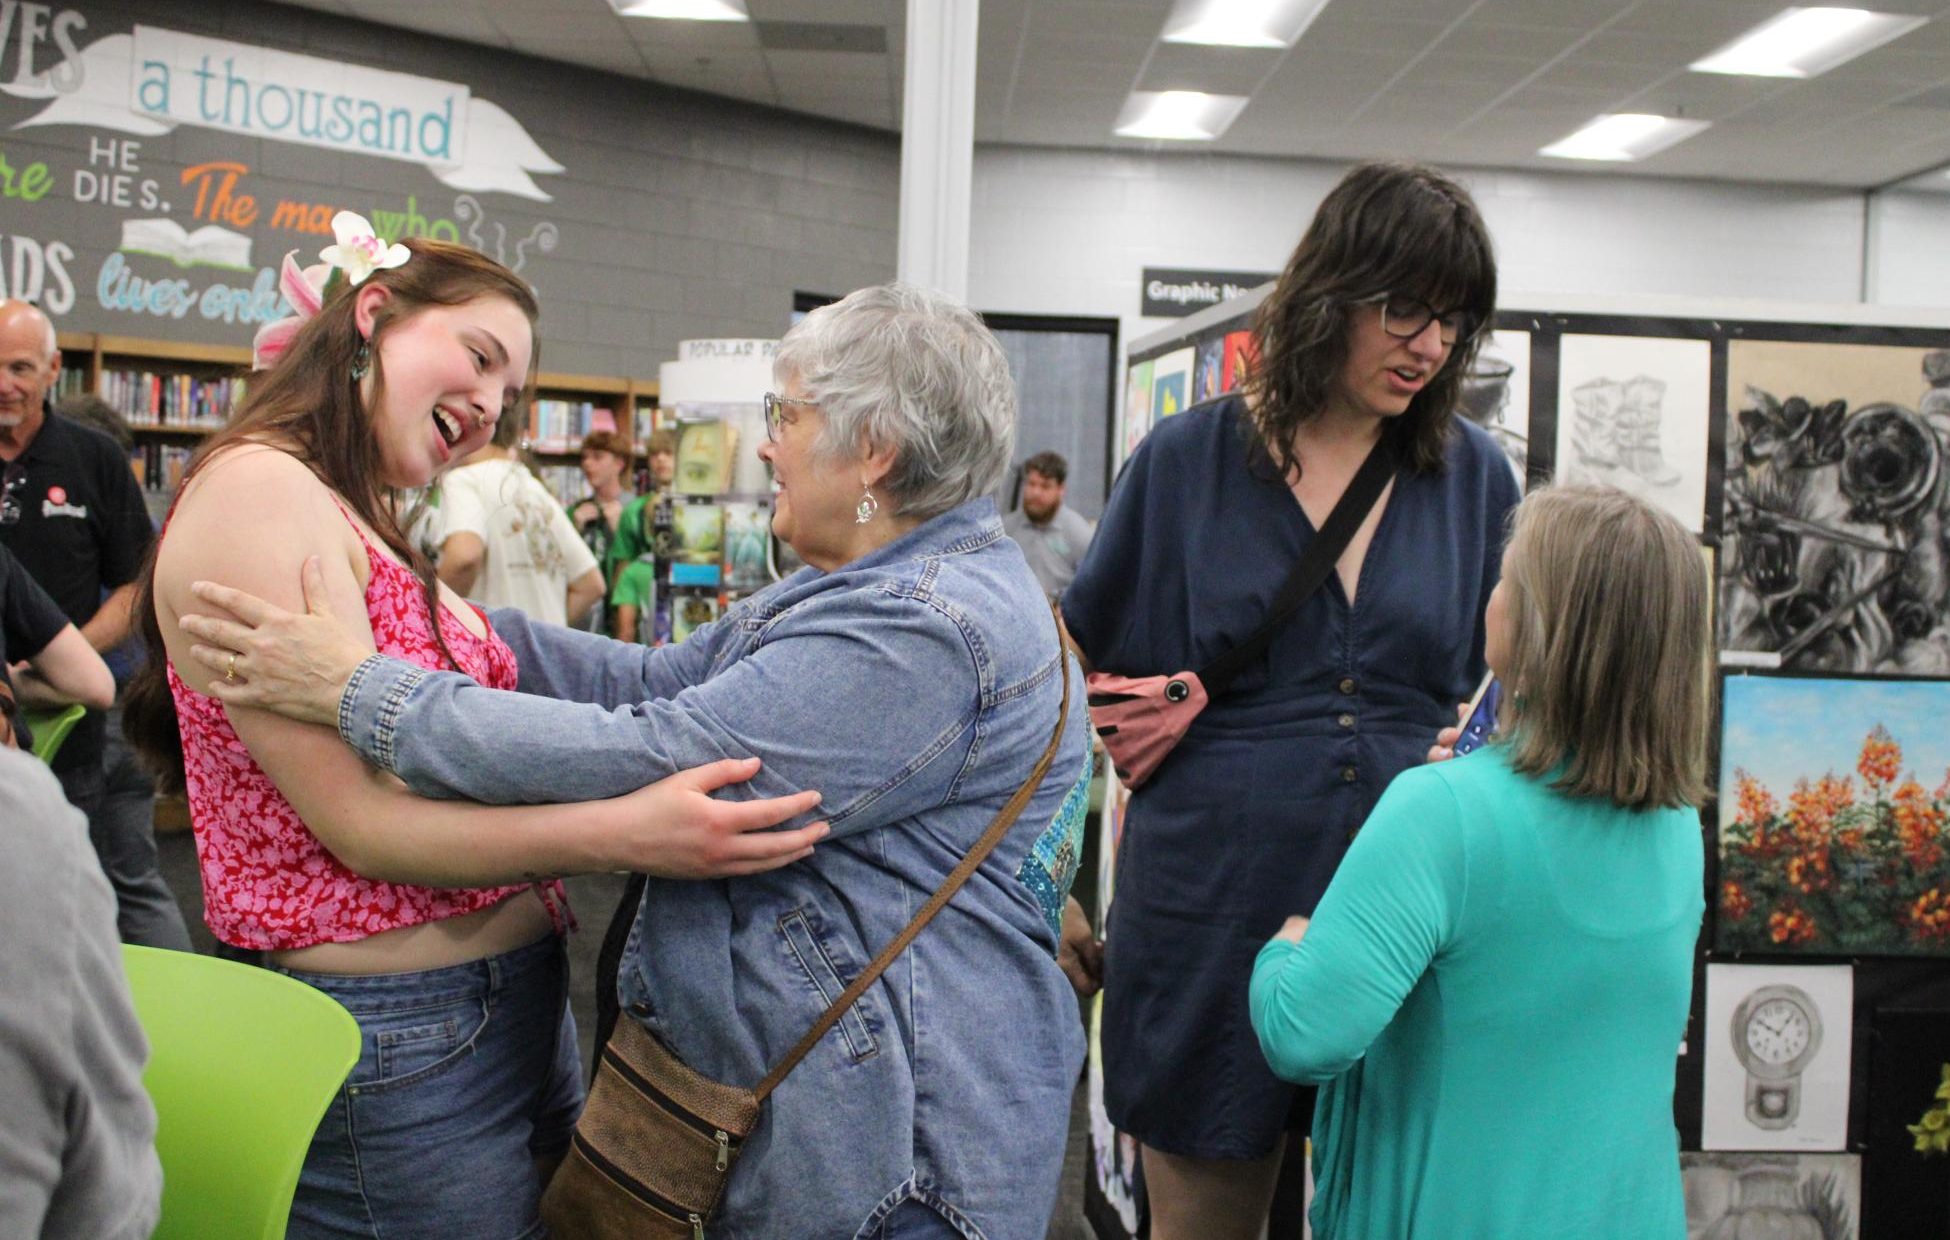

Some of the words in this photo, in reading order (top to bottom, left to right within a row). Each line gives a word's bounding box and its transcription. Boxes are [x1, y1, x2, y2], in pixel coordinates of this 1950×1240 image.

[138, 60, 170, 114] a
[193, 54, 455, 160] thousand
[90, 136, 141, 172] HE
[73, 169, 171, 212] DIES.
[180, 161, 257, 227] The
[271, 200, 334, 235] ma
[371, 192, 460, 246] who
[0, 233, 76, 316] DS
[97, 251, 199, 319] lives
[1147, 279, 1220, 306] Graphic
[1221, 282, 1251, 302] No
[688, 341, 754, 358] POPULAR
